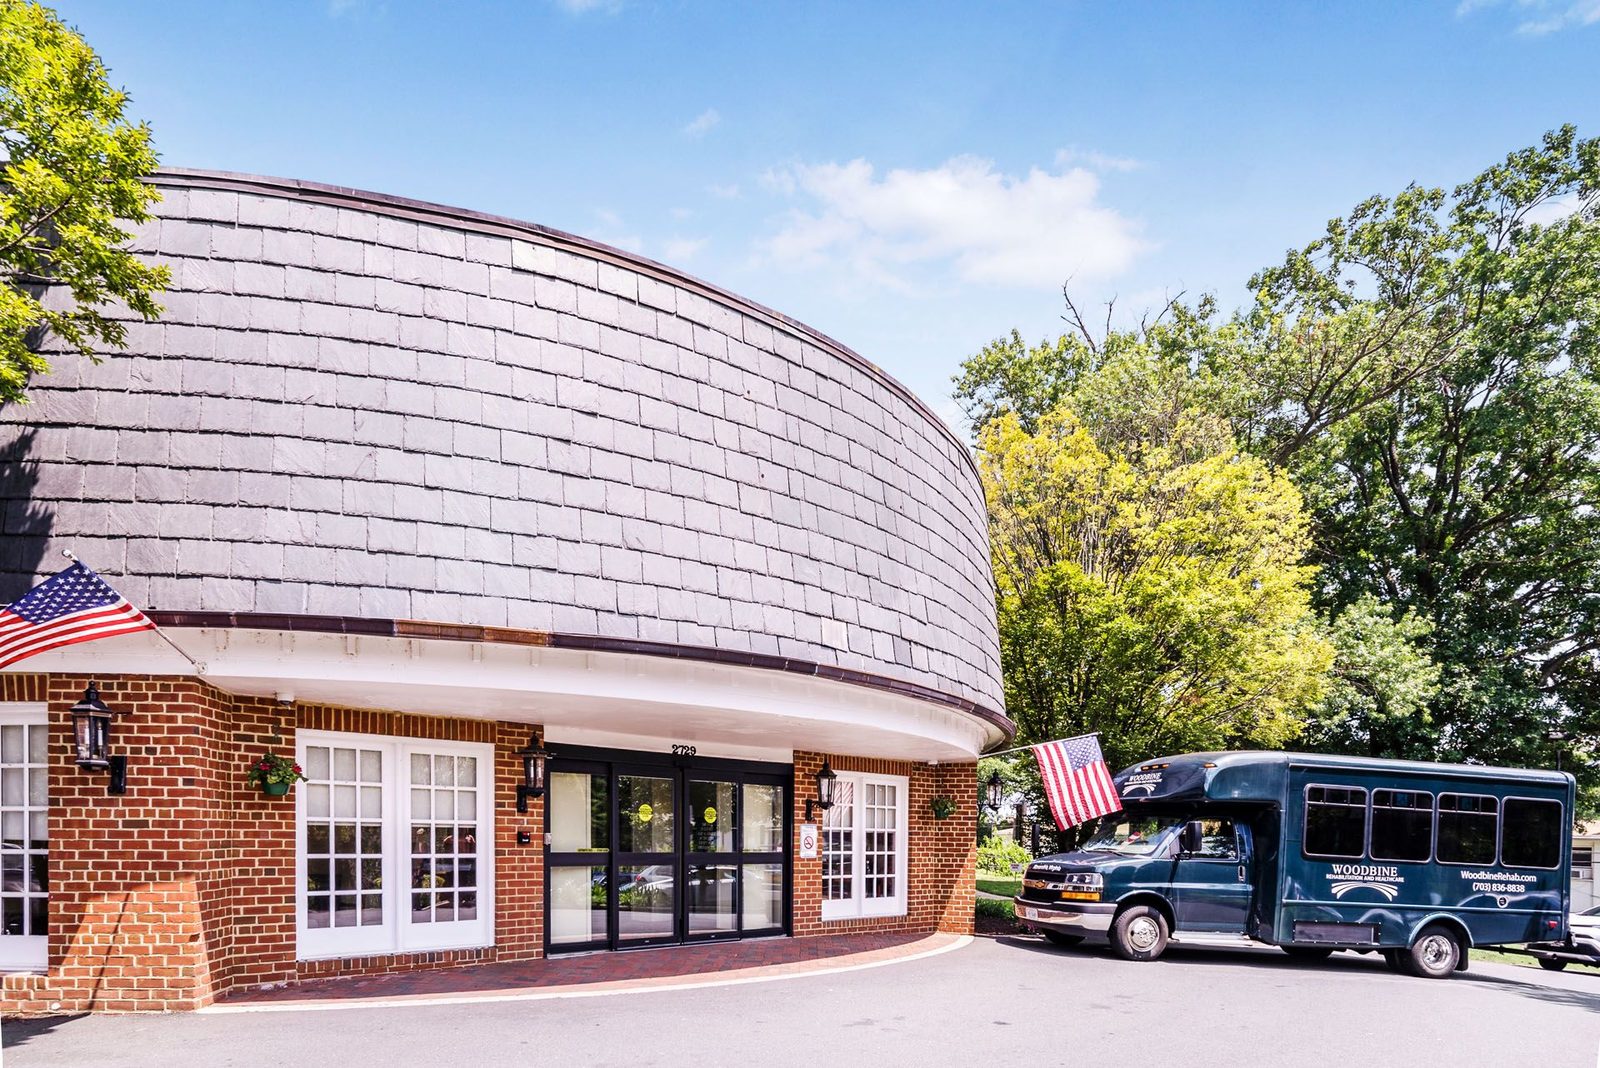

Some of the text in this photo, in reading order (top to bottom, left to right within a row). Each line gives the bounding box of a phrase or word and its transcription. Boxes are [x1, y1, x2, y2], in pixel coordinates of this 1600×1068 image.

[672, 744, 697, 756] 2729
[1129, 772, 1162, 781] WOODBINE
[1332, 864, 1398, 876] WOODBINE
[1461, 870, 1536, 882] WoodbineRehab.com
[1472, 882, 1526, 893] (703) 836-8838
